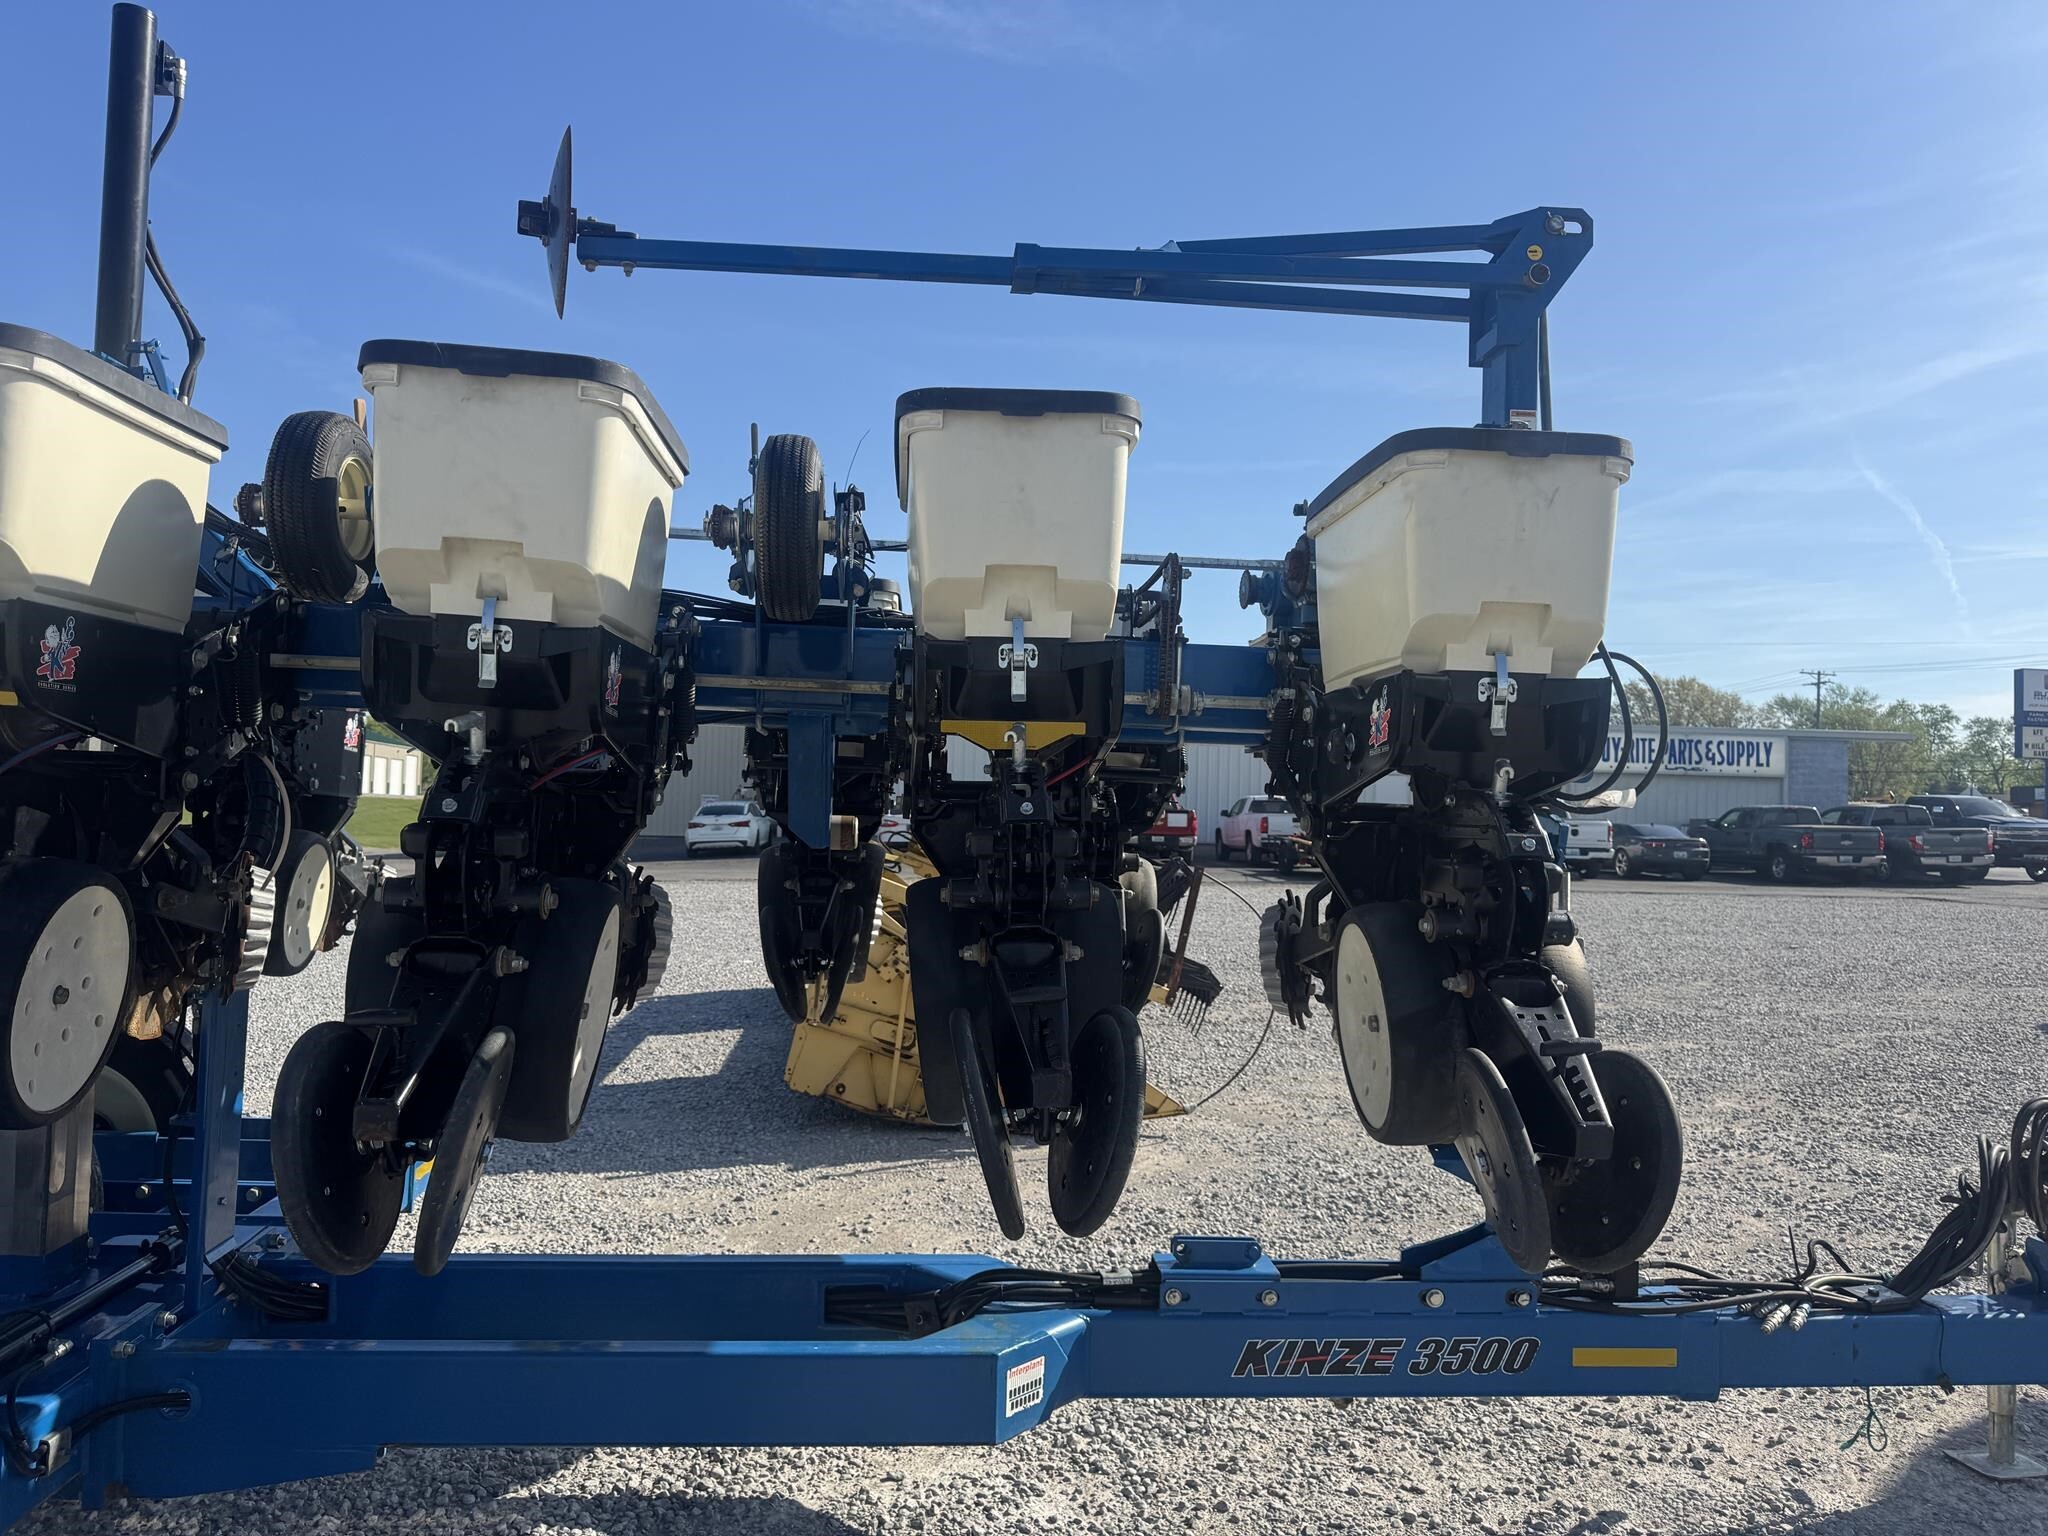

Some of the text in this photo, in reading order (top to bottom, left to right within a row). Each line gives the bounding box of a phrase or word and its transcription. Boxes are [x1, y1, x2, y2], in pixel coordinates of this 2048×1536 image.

[1705, 740, 1717, 766] &
[1717, 740, 1774, 768] SUPPLY
[1009, 1358, 1042, 1378] Interplant
[1231, 1336, 1542, 1377] KINZE 3500
